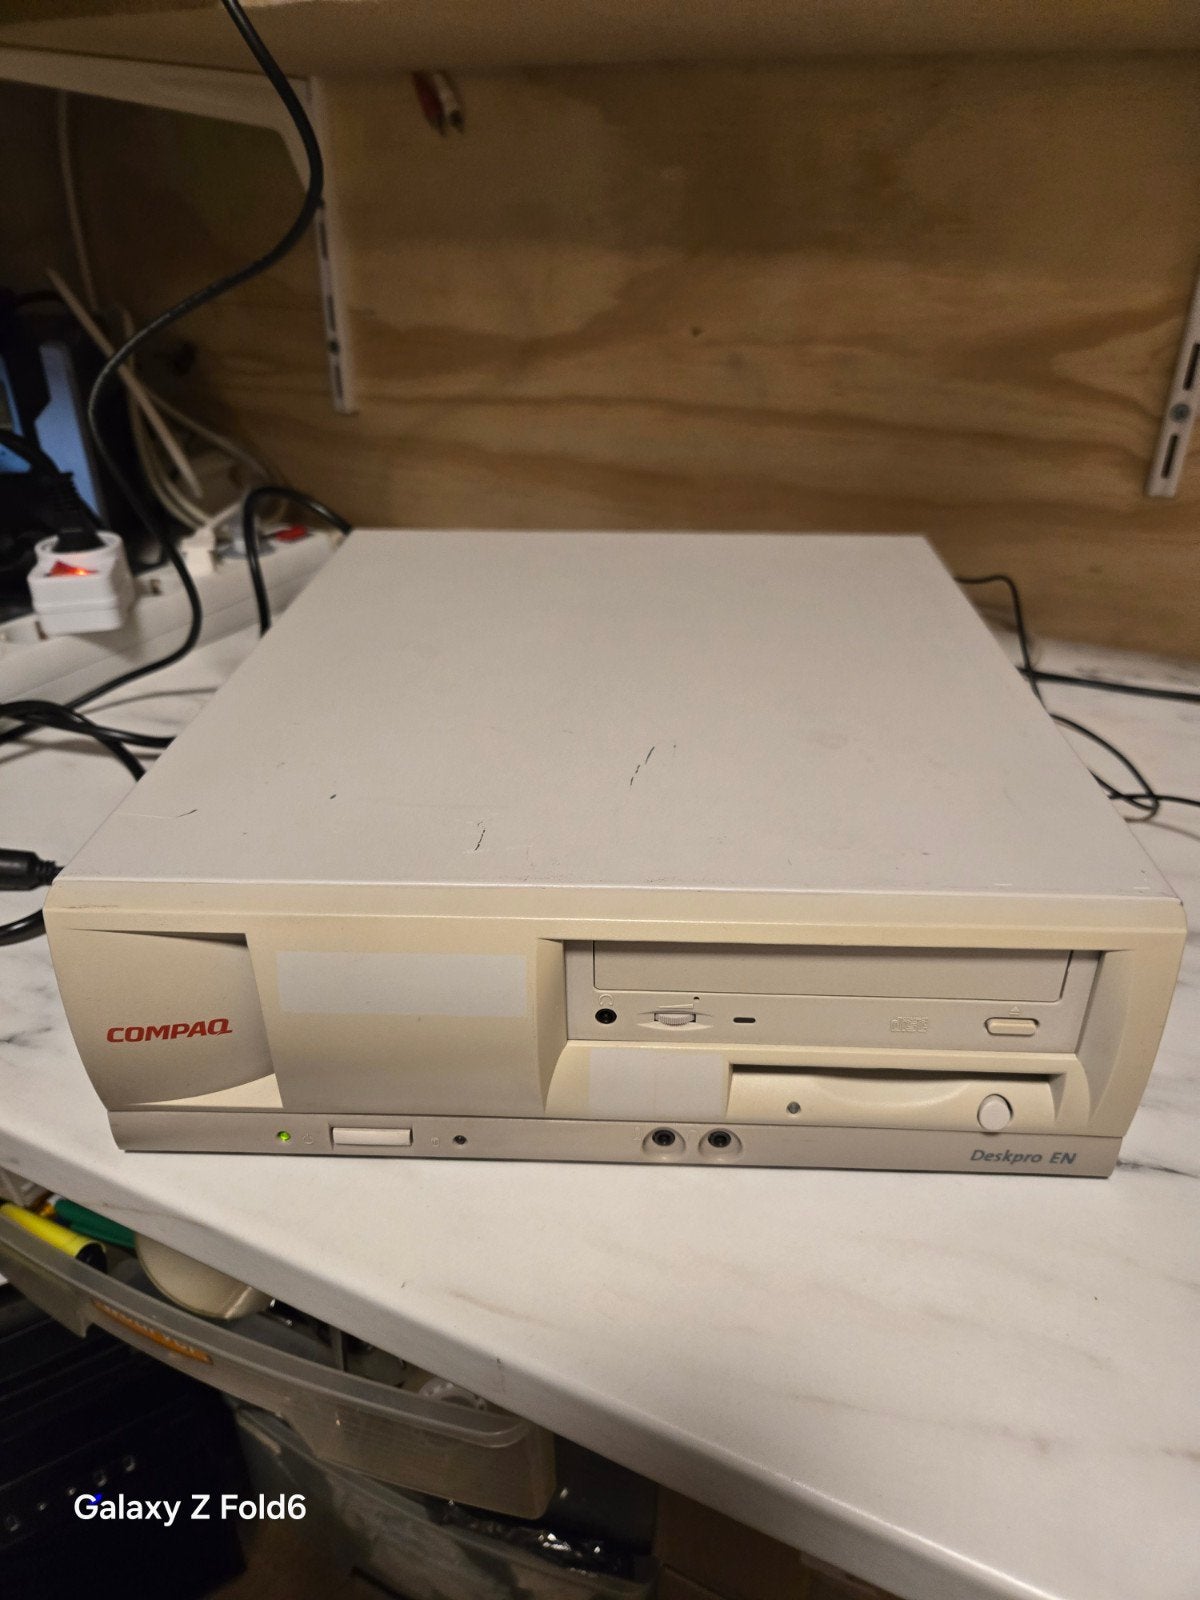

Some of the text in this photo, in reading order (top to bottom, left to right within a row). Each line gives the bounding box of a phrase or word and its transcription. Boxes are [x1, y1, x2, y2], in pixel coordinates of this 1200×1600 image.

[106, 1018, 233, 1043] COMPAQ
[970, 1149, 1077, 1165] Deskpro EN
